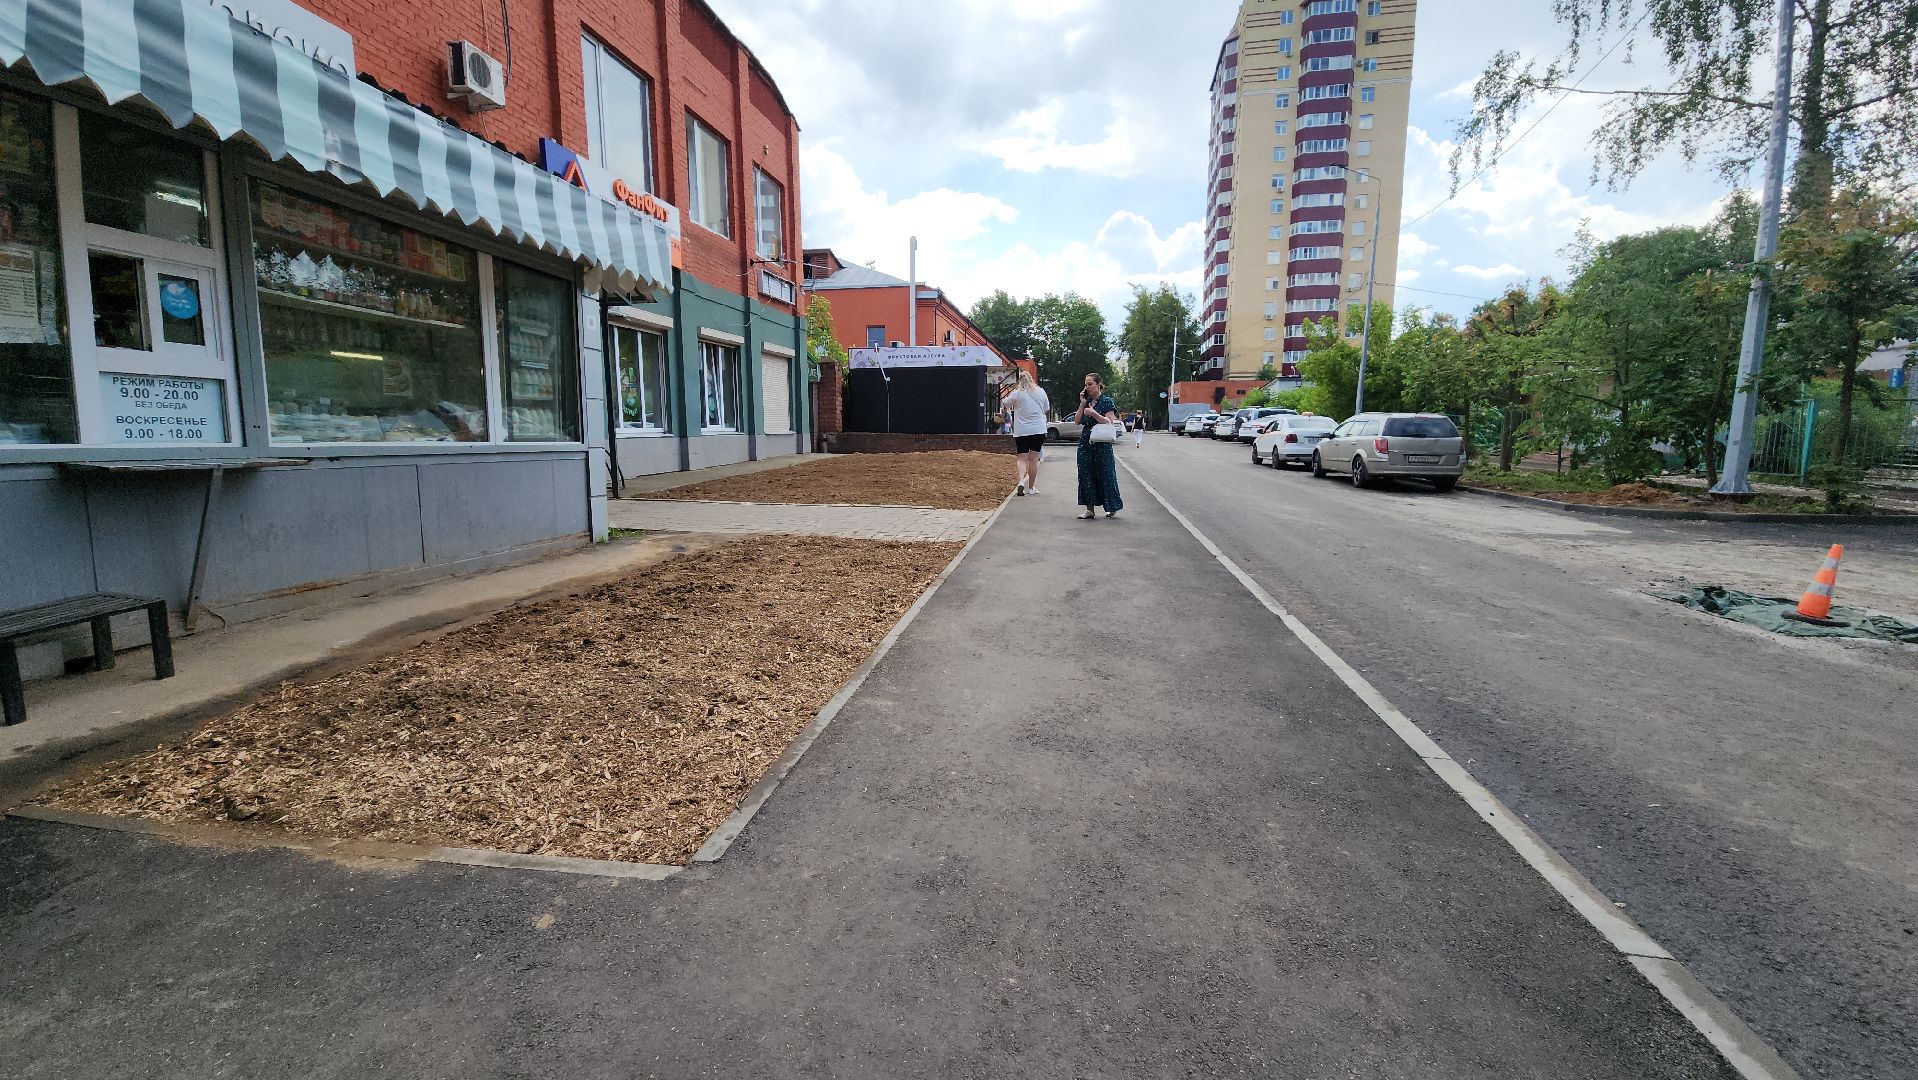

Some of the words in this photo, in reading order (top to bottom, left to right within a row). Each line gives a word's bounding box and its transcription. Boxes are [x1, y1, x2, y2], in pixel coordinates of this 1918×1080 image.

[612, 179, 670, 222] ФанФит
[112, 376, 155, 387] РЕЖИМ
[158, 379, 204, 390] РАБОТЫ
[120, 387, 150, 399] 9.00
[163, 389, 199, 400] 20.00
[135, 400, 153, 408] БЕЗ
[156, 401, 187, 410] ОБЕДА
[116, 415, 208, 426] ВОСКРЕСЕНЬЕ
[125, 428, 154, 439] 9.00
[168, 429, 203, 439] 18.00
